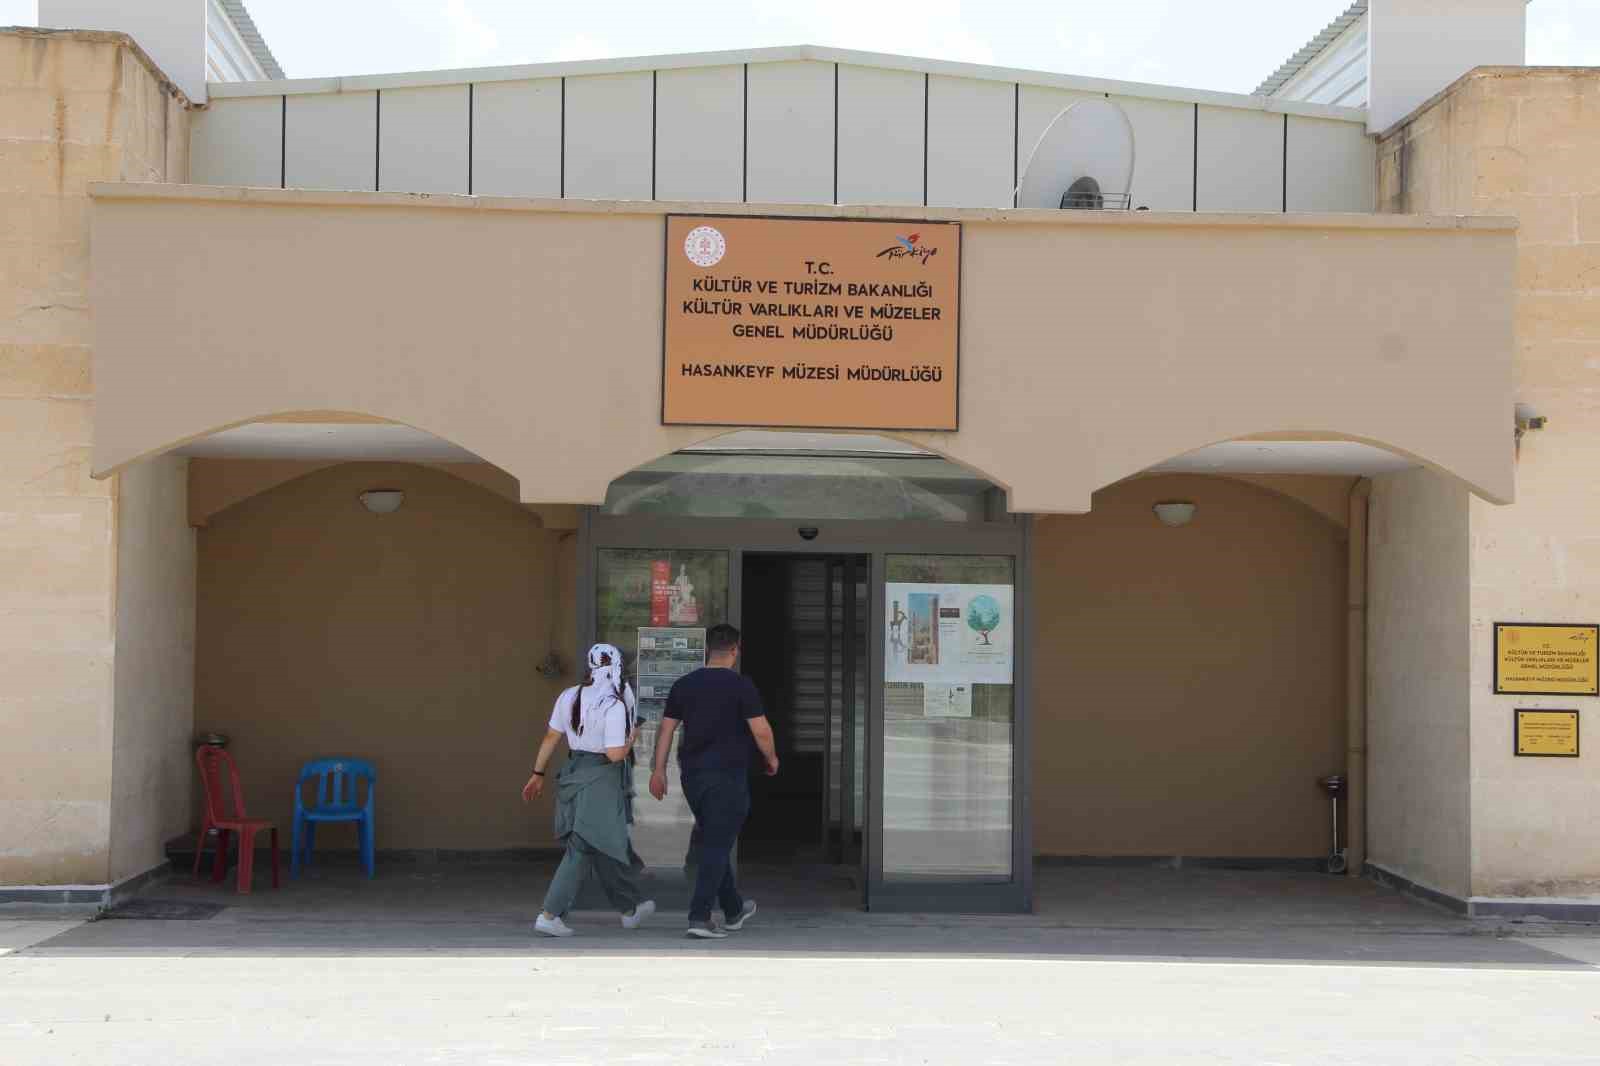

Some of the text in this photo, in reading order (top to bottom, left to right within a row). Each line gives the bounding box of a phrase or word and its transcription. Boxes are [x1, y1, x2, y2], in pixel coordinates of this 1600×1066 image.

[875, 245, 938, 265] Türkiye
[804, 261, 835, 275] T.C.
[692, 276, 933, 298] KÜLTÜR VE TURİZM BAKANLIĞI
[682, 298, 941, 320] KÜLTÜR VARLIKLARI VE MÜZELER
[732, 323, 893, 341] GENEL MÜDÜRLÜĞÜ
[681, 363, 943, 382] HASANKEYF MÜZESİ MÜDÜRLÜĞÜ
